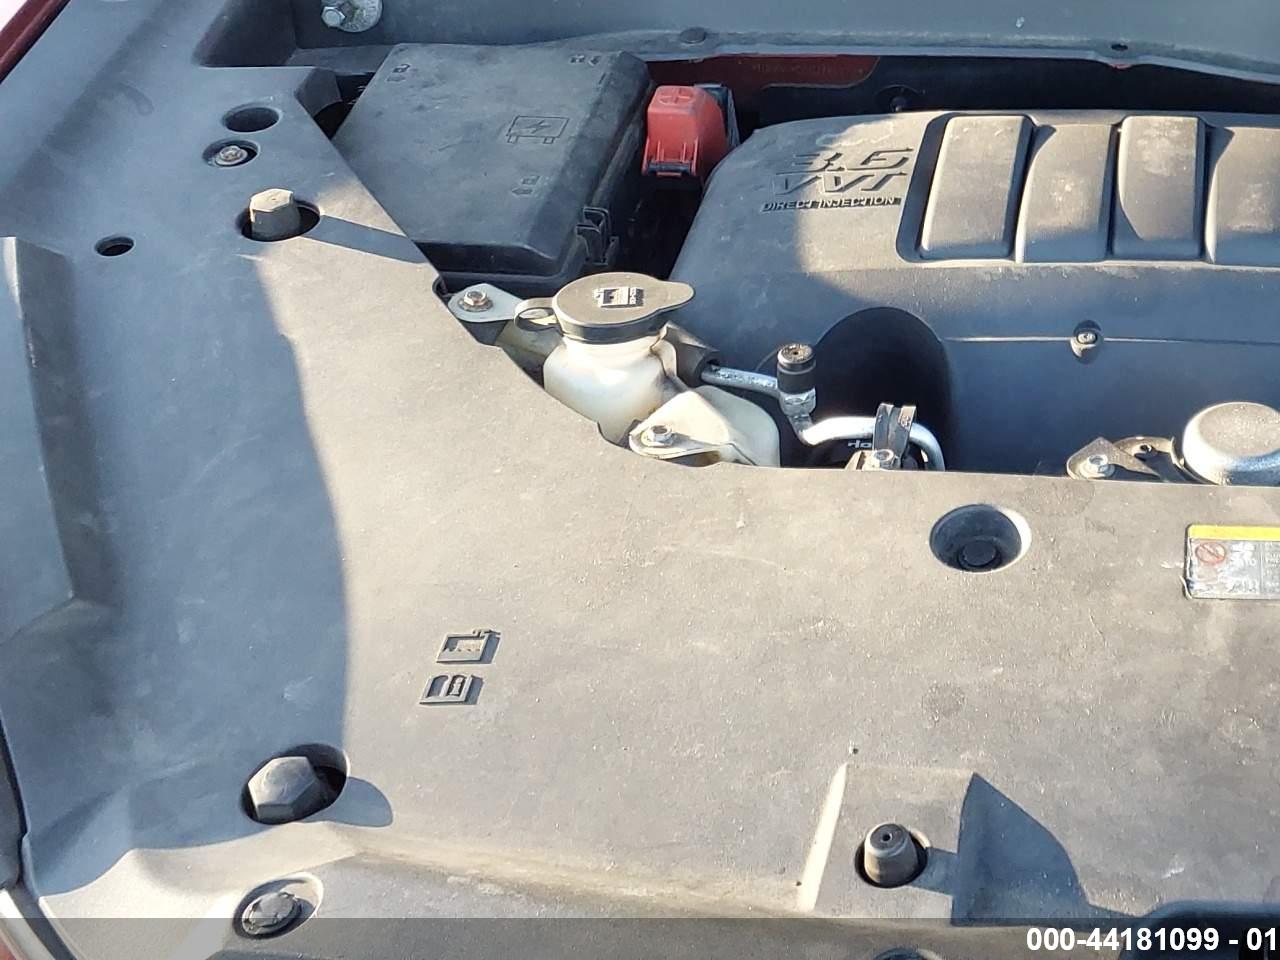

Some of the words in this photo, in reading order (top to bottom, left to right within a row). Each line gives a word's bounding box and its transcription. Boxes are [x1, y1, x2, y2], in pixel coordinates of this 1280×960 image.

[772, 171, 908, 196] VVT
[761, 198, 815, 213] DIRECT
[818, 196, 896, 209] INJECTION
